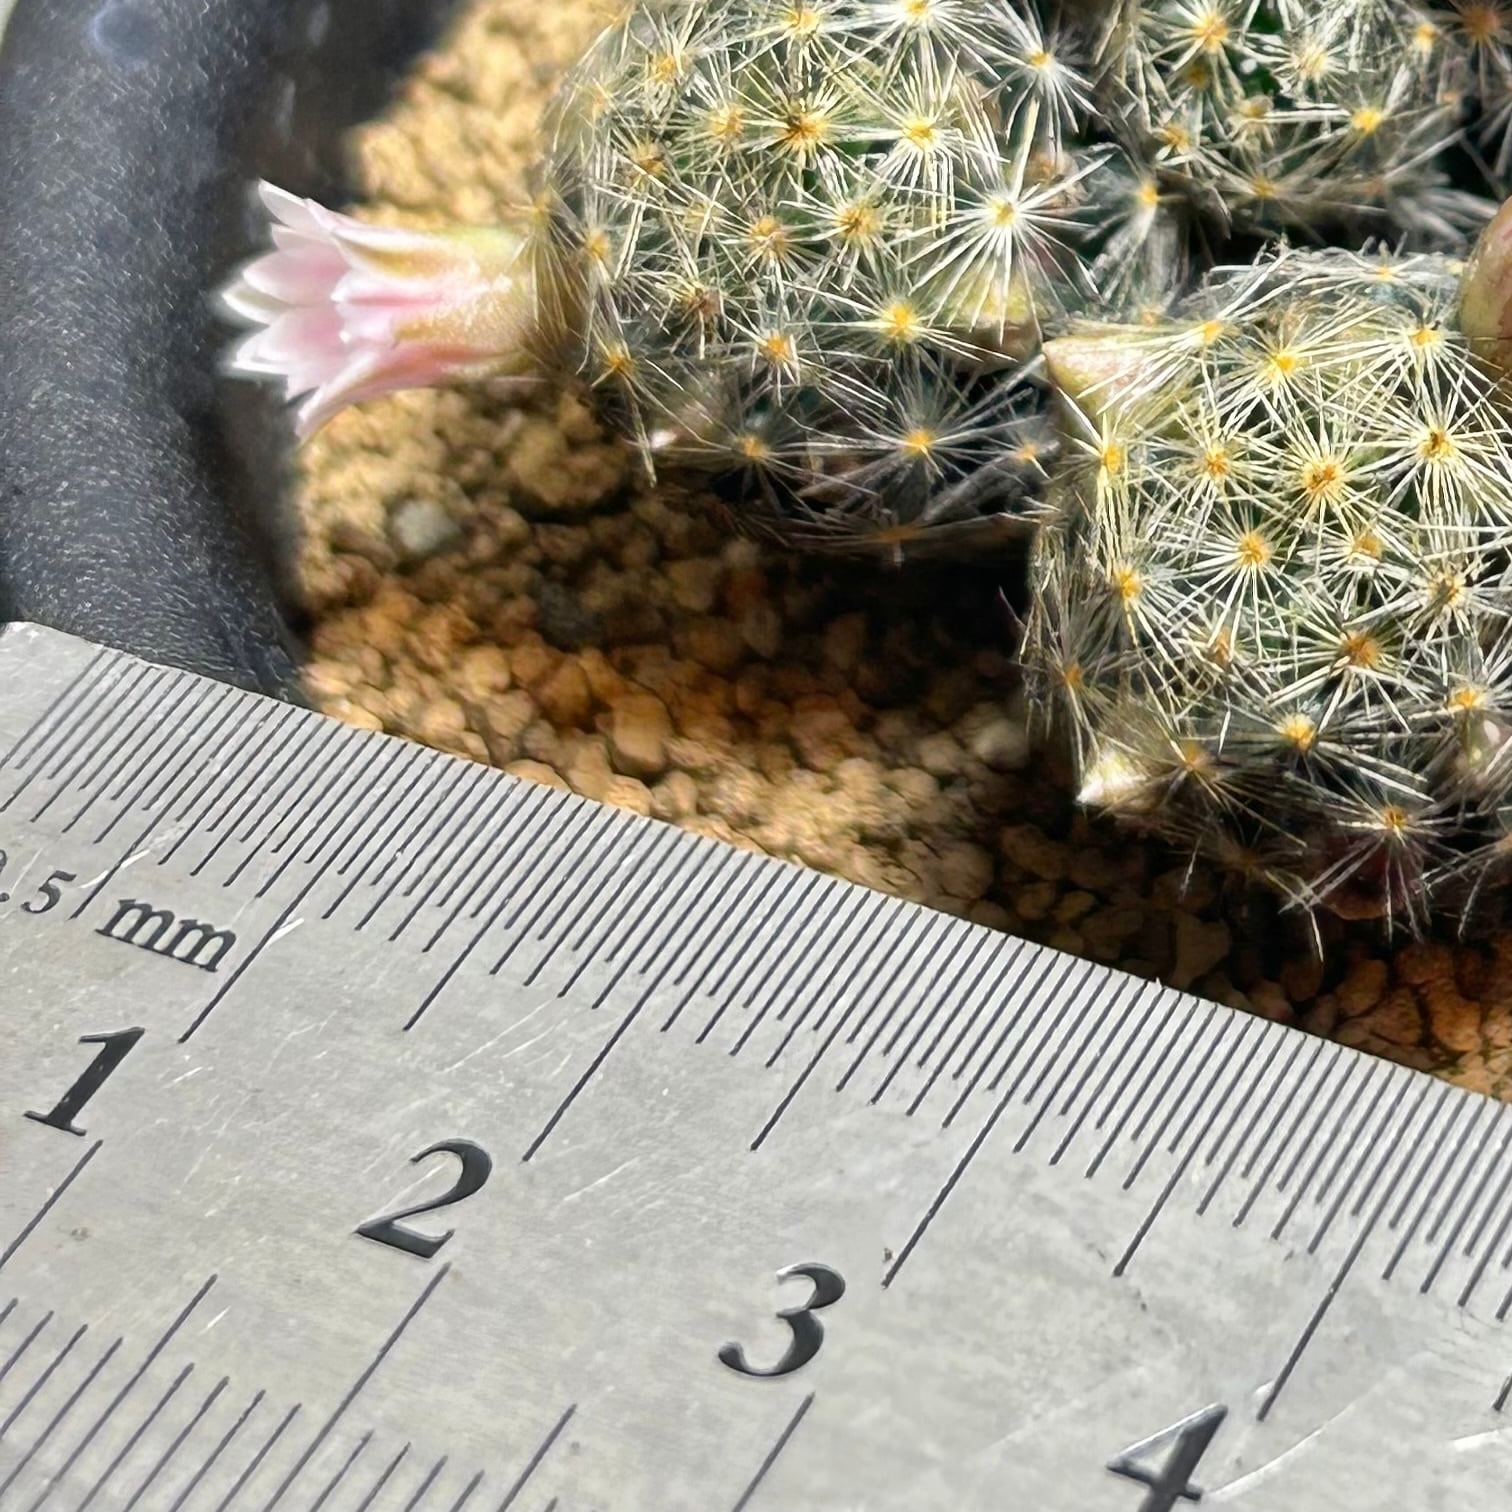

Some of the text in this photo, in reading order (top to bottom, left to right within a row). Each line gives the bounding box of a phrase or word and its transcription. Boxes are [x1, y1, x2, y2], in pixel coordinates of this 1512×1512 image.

[0, 849, 237, 973] .5 mm
[23, 1027, 1228, 1512] 1 2 3 4
